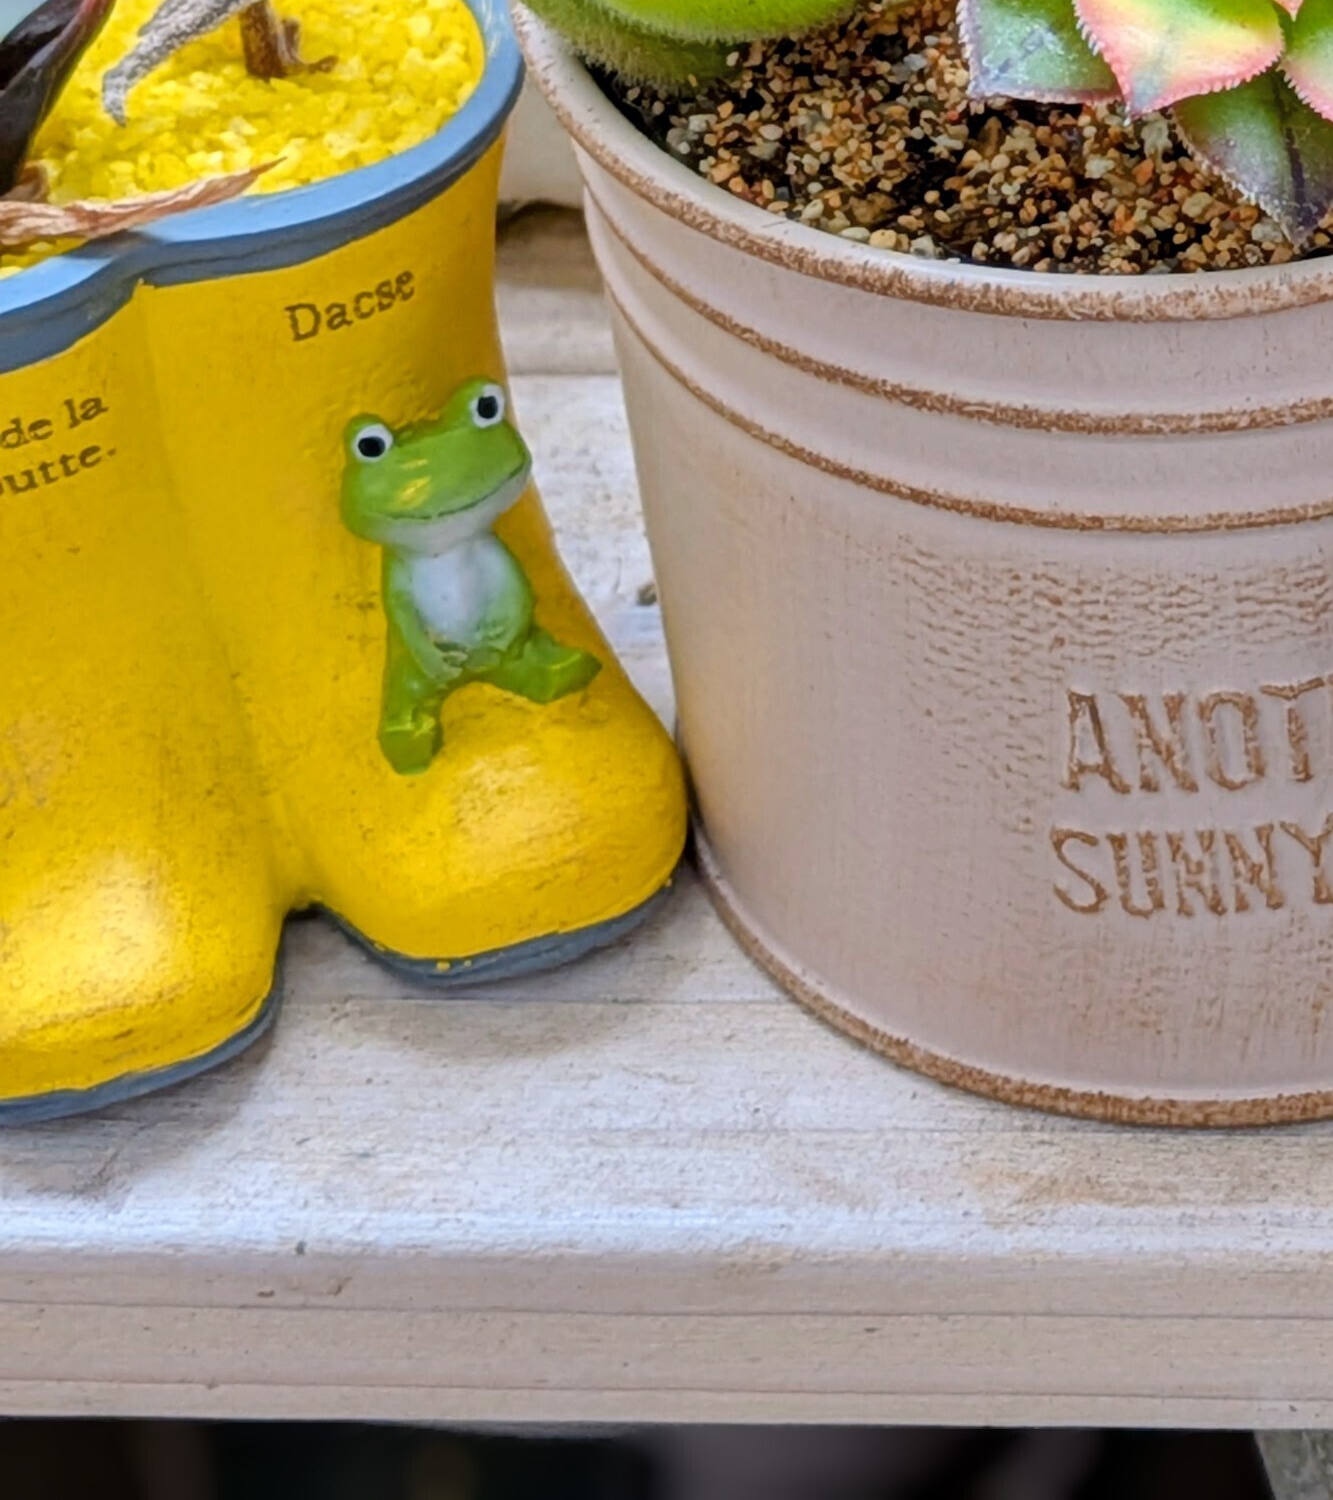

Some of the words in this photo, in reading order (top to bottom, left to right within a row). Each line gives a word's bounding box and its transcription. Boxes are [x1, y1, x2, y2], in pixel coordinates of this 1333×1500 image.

[0, 417, 54, 449] de
[63, 396, 109, 430] la
[0, 444, 117, 496] utte.
